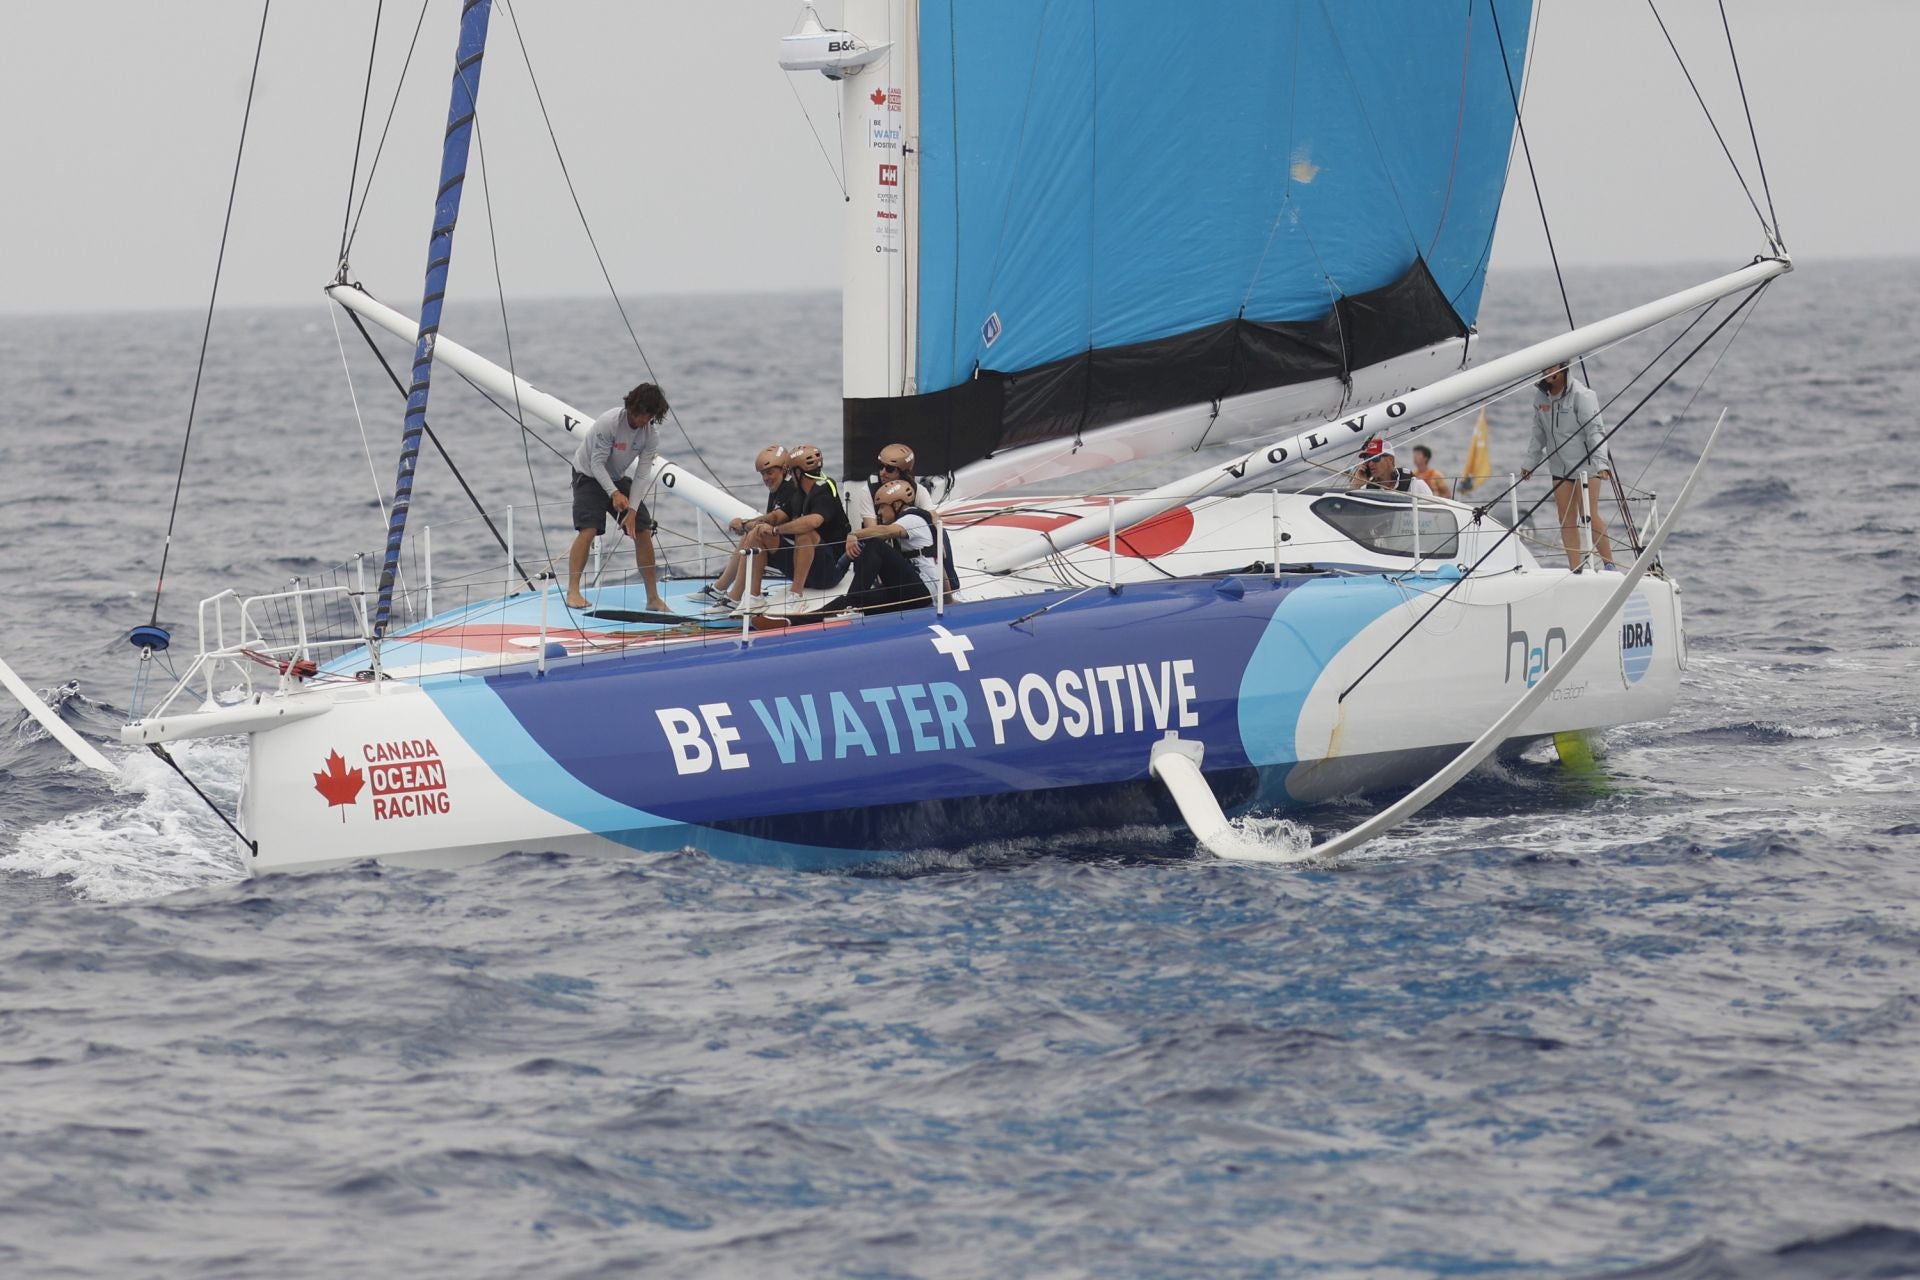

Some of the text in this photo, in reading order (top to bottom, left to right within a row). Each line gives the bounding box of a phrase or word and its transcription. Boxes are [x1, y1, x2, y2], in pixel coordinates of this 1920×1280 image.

[1223, 401, 1407, 479] VOLVO
[1622, 621, 1653, 650] IDRA
[655, 659, 1199, 775] BE WATER POSITIVE
[362, 739, 439, 763] CANADA
[373, 763, 444, 791] OCEAN
[373, 792, 450, 820] RACING
